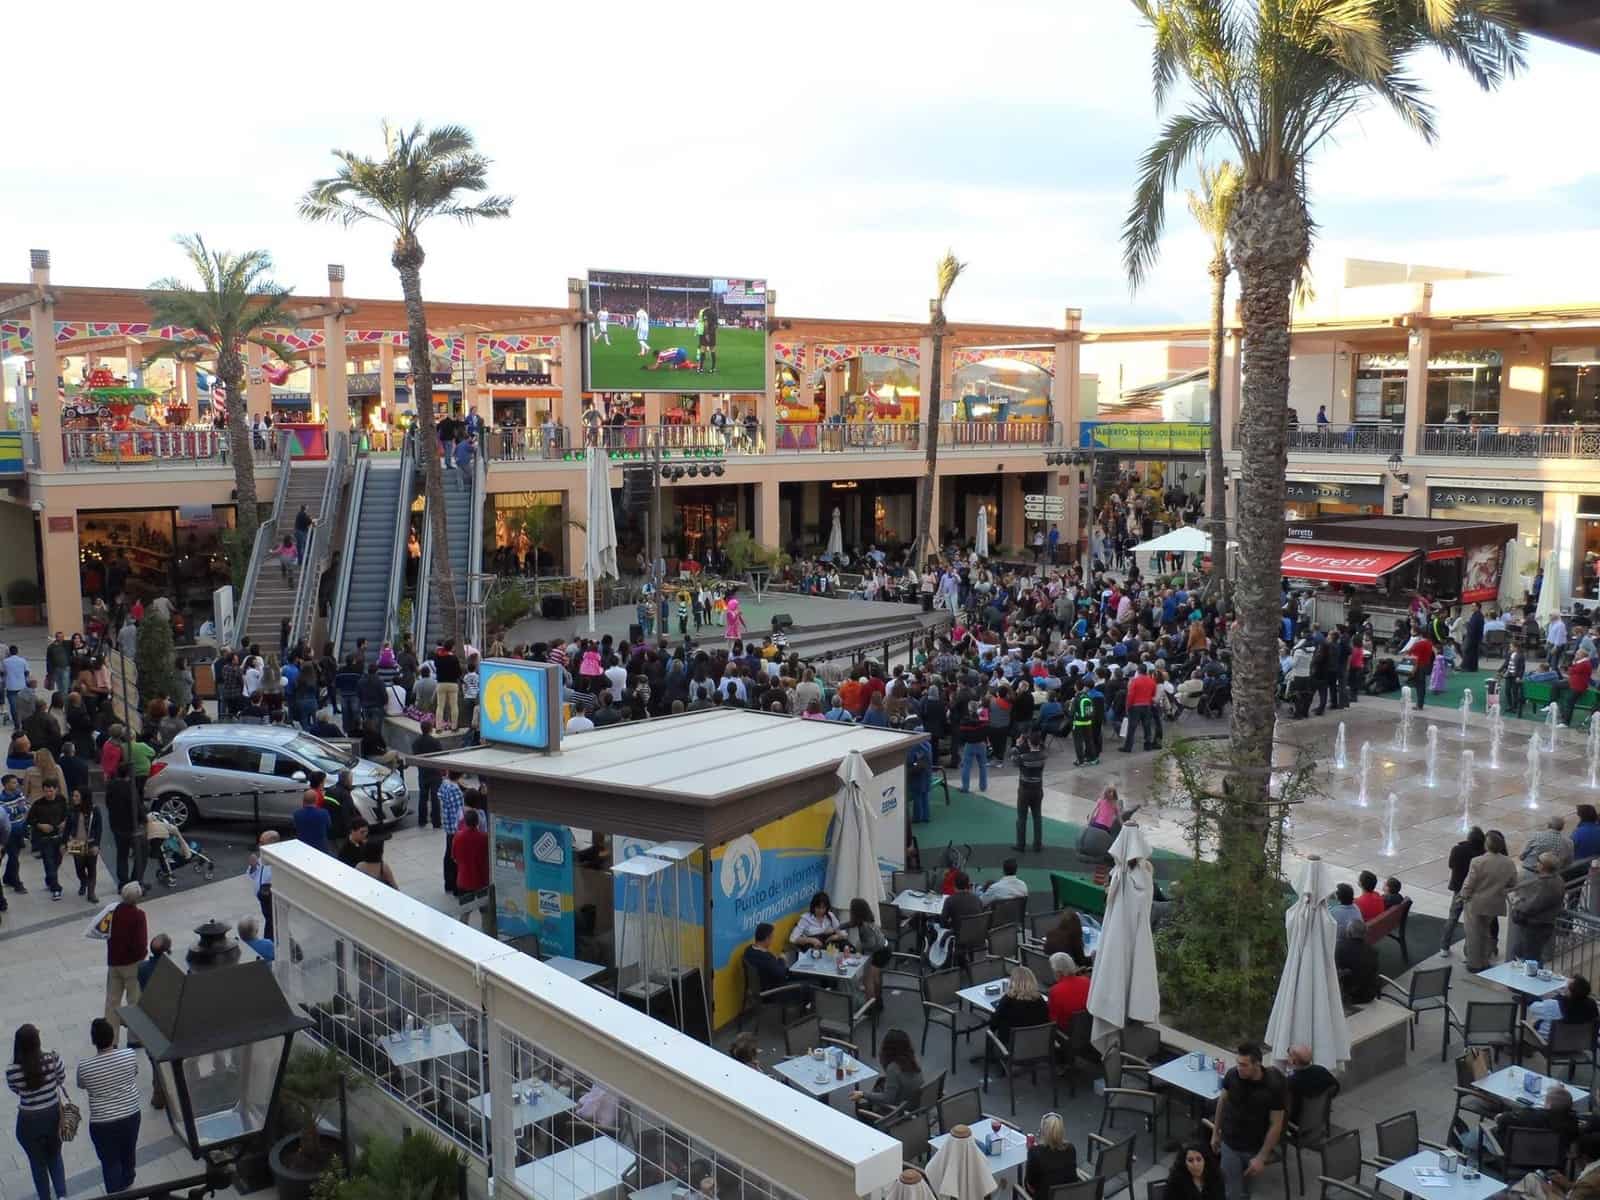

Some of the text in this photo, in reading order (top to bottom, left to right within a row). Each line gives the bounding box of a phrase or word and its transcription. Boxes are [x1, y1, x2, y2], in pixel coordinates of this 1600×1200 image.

[1311, 488, 1352, 498] HOME
[1434, 492, 1537, 506] ZARA HOME
[1280, 551, 1381, 568] ferretti
[735, 889, 767, 916] Punto
